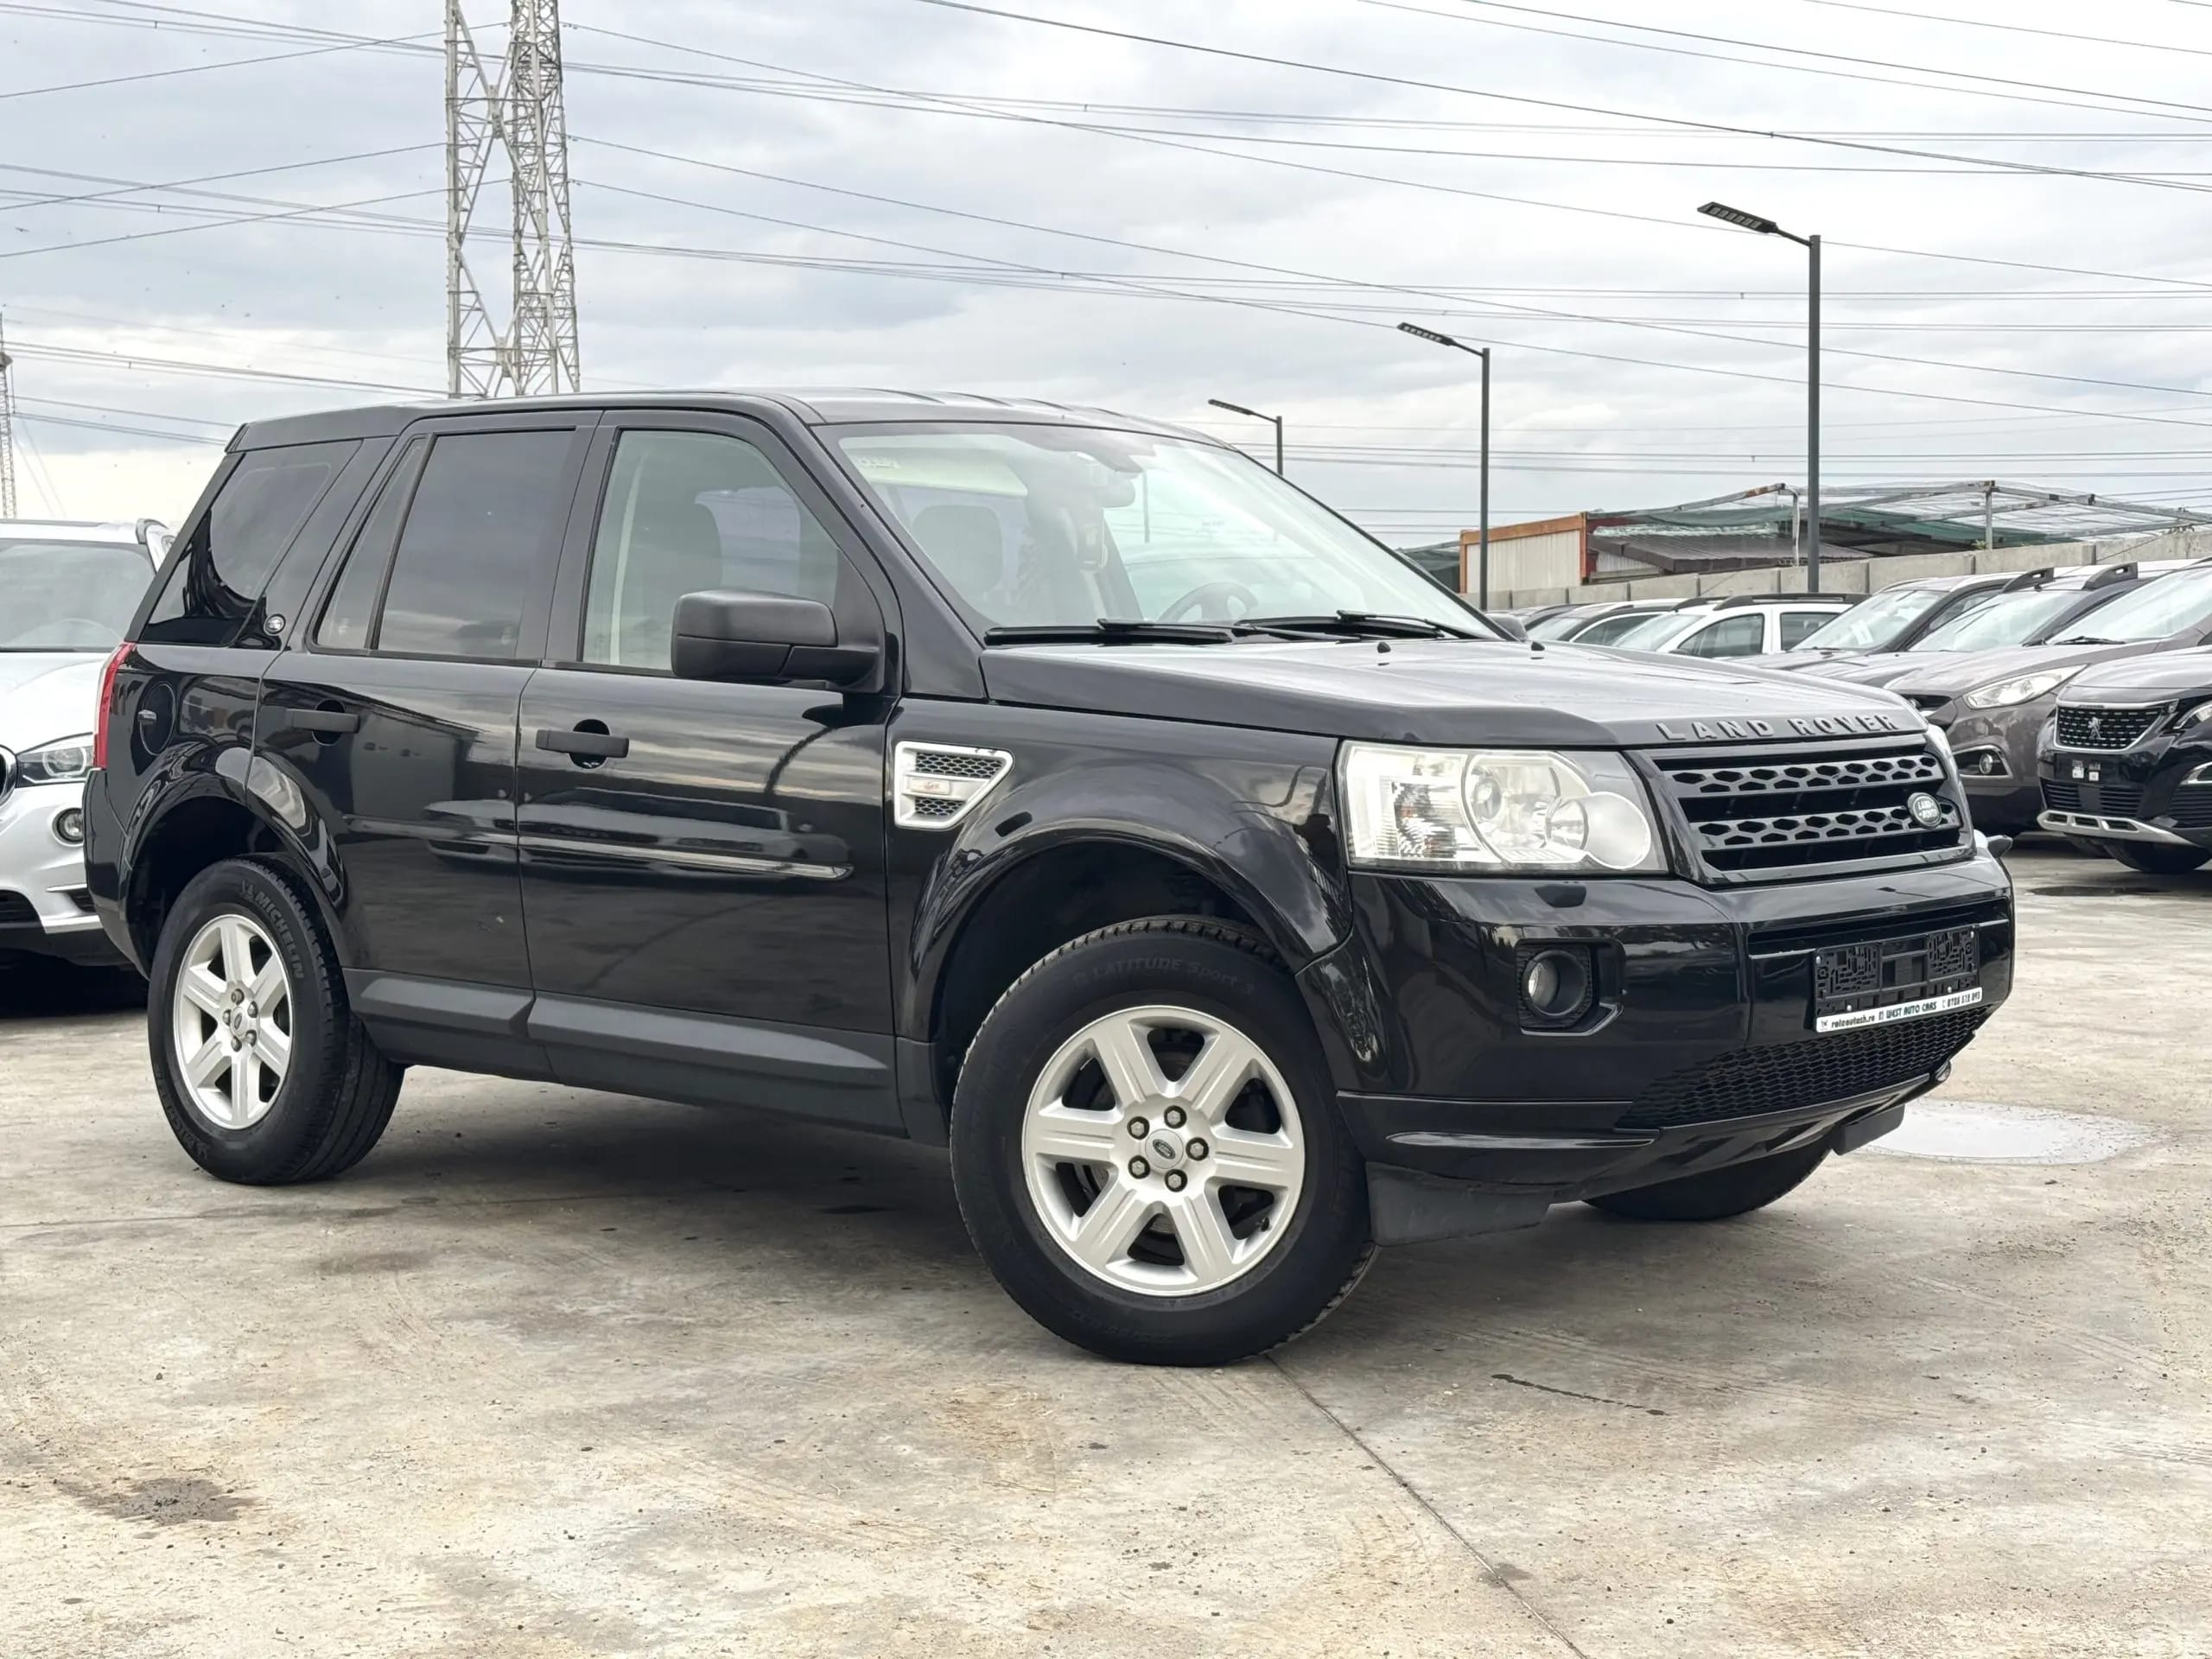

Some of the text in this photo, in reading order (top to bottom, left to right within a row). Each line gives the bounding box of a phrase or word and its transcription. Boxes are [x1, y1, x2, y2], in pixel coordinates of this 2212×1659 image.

[1656, 715, 1899, 741] LAND ROVER
[254, 891, 304, 978] MICHELIN
[1092, 957, 1183, 979] LATITUDE
[1886, 1007, 1902, 1018] WEST
[1904, 1005, 1920, 1015] AUTO
[1922, 1001, 1937, 1011] CARS
